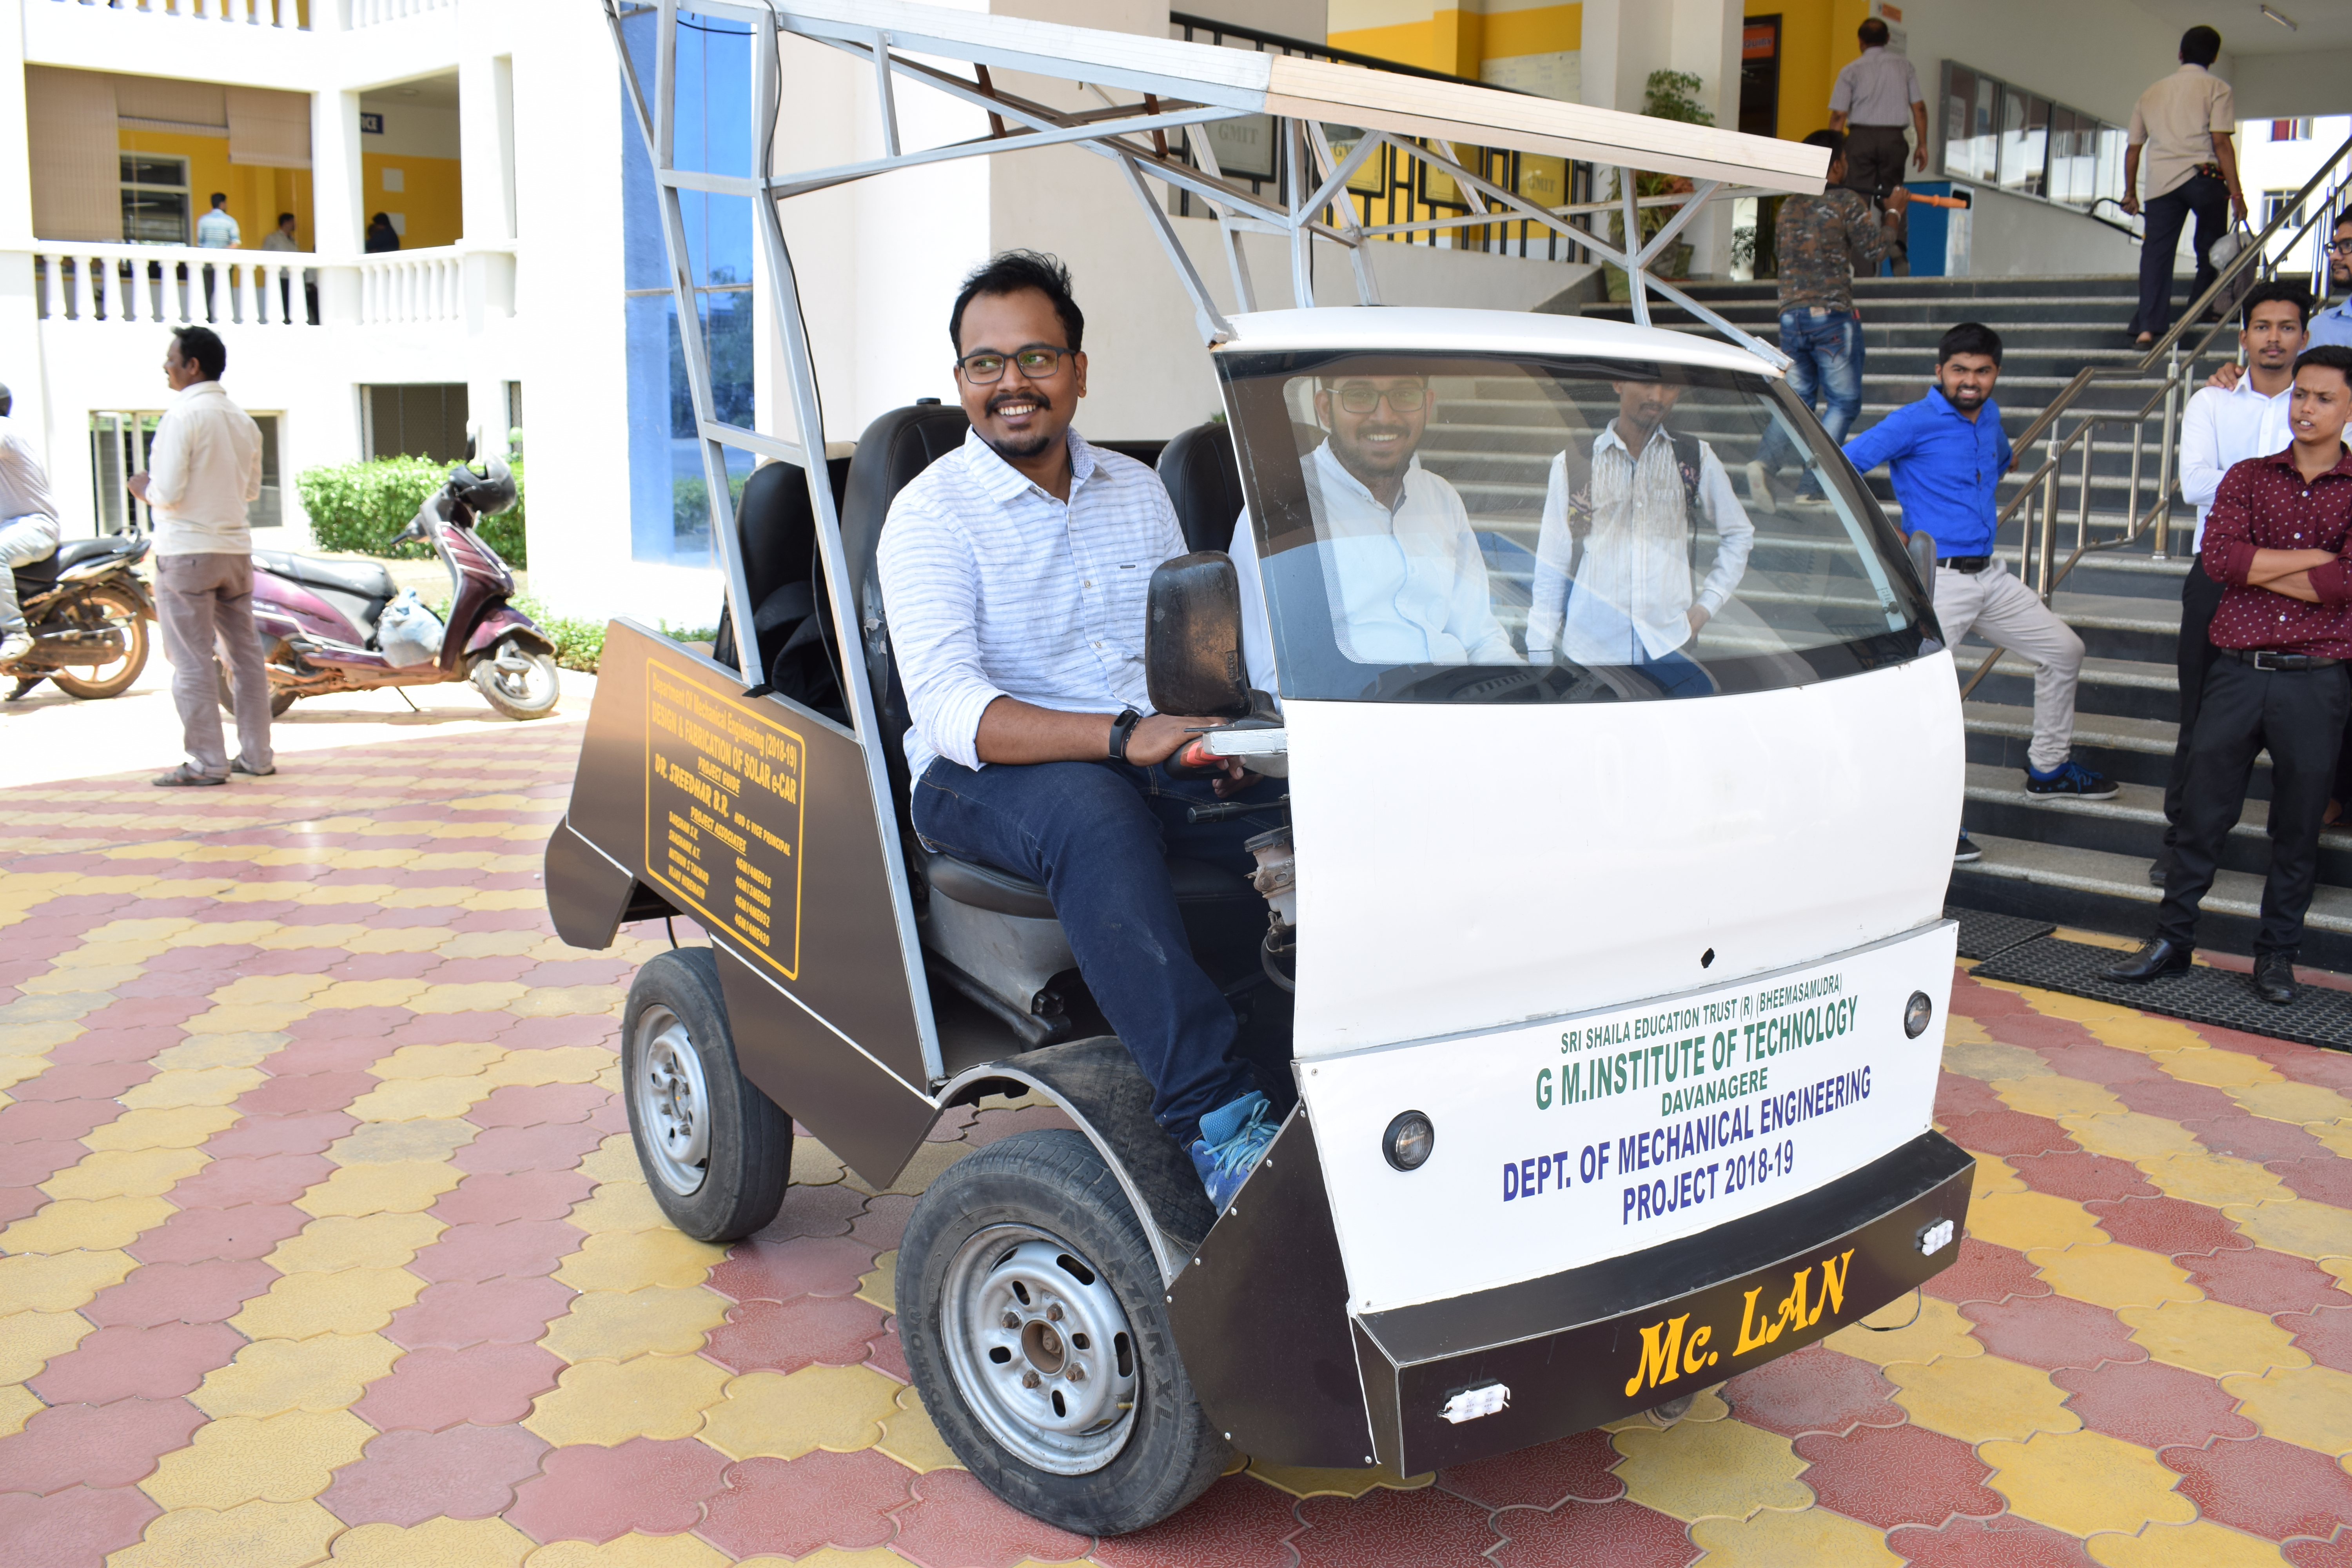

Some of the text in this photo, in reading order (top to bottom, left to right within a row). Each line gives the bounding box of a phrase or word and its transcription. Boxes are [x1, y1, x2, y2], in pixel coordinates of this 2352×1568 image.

[1218, 122, 1259, 145] GMIT
[1528, 175, 1555, 193] GMIT
[652, 700, 797, 804] DESIGN & FABRICATION OF SOLAR e-CAR
[653, 672, 797, 775] Department Of Mechanical Engineering (2018-19)
[655, 753, 668, 779] DR.
[669, 763, 711, 808] SREEDHAR
[713, 790, 729, 817] B.R.
[734, 811, 745, 827] HOD
[751, 822, 763, 838] VICE
[763, 829, 790, 856] PRINCIPAL
[698, 756, 740, 794] PROJECT GUIDE
[690, 806, 746, 852] PROJECT ASSOCIATES
[736, 856, 771, 889] 4GM14ME018
[734, 913, 770, 947] 4GM14ME430
[1536, 1068, 1552, 1111] G
[1713, 1028, 1738, 1071] OF
[1744, 995, 1858, 1063] TECHNOLOGY
[1561, 973, 1842, 1054] SRI SHAILA EDUCATION TRUST (R) (BHEEMASAMUDRA)
[1503, 1065, 1871, 1203] DEPT. OF MECHANICAL ENGINEERING
[1662, 1067, 1768, 1117] DAVANAGERE
[1623, 1139, 1794, 1226] PROJECT 2018-19
[1059, 1207, 1173, 1429] AMAZER XL
[1624, 1248, 1855, 1397] Mc. LAN
